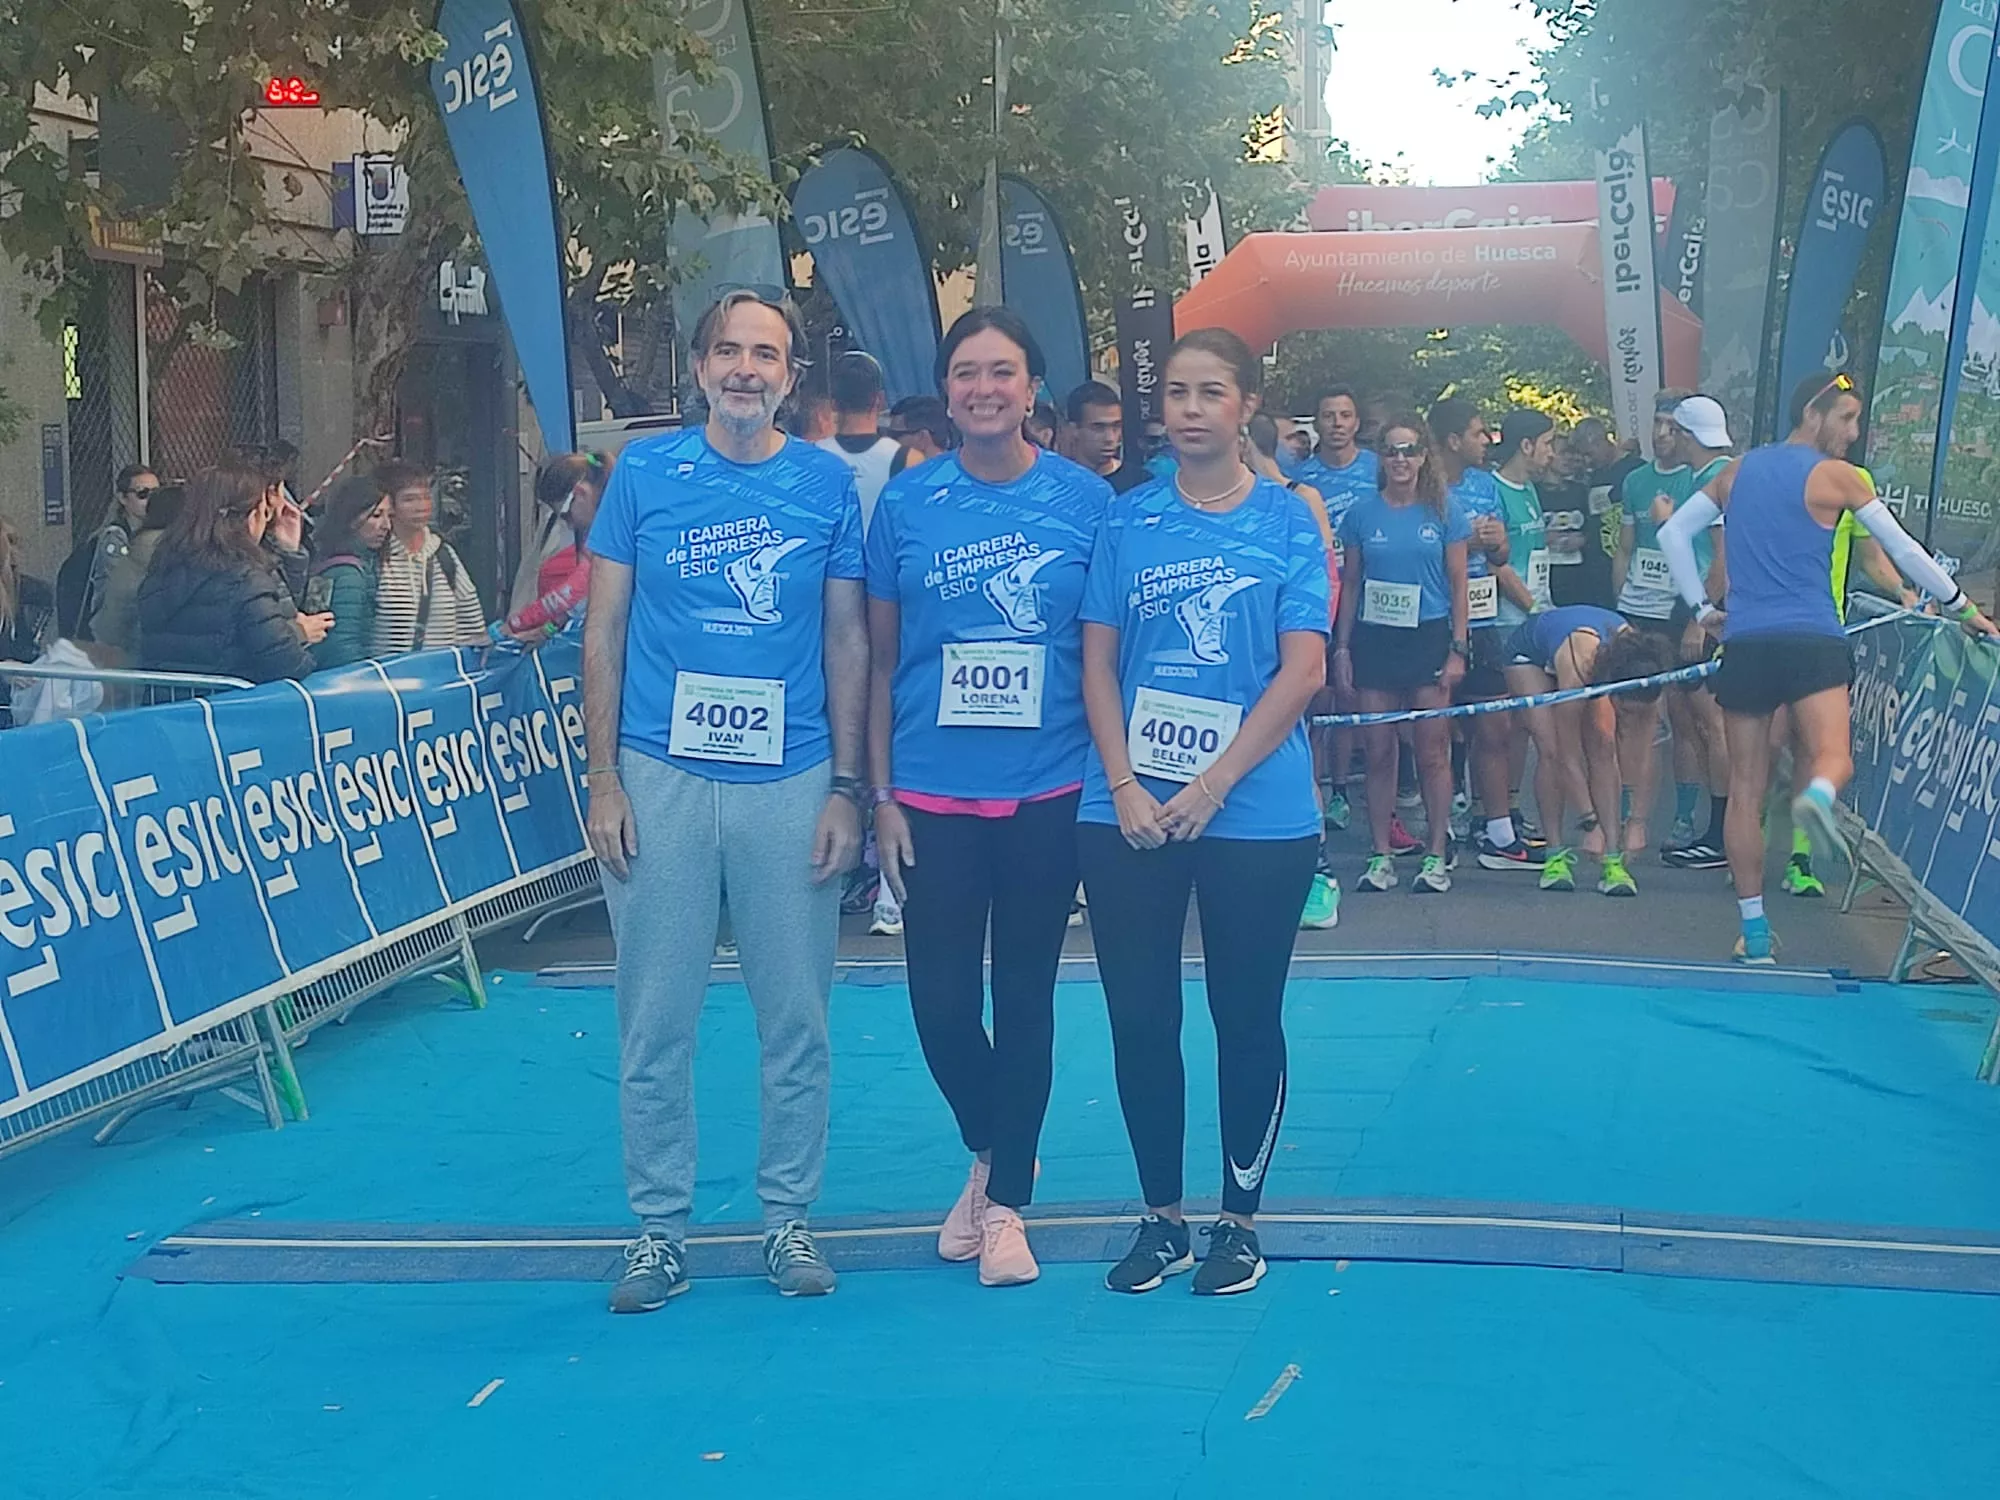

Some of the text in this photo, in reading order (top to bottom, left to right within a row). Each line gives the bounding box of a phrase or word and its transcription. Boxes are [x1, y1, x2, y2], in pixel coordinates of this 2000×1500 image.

[1822, 185, 1873, 228] esic
[1284, 244, 1557, 272] Ayuntamiento de Huesca
[1337, 269, 1502, 302] Hacemos deporte
[680, 515, 771, 546] I CARRERA
[666, 530, 783, 565] de EMPRESAS
[934, 531, 1027, 567] I CARRERA
[680, 558, 720, 579] ESIC
[924, 543, 1040, 588] de EMPRESAS
[1134, 555, 1224, 587] I CARRERA
[939, 577, 977, 600] ESIC
[1142, 568, 1236, 601] EMPRESAS
[1371, 590, 1411, 609] 3035
[951, 665, 1029, 691] 4001
[961, 693, 1020, 704] LORENA
[685, 702, 769, 731] 4002
[709, 732, 744, 744] IVAN
[1141, 718, 1219, 753] 4000
[1152, 748, 1197, 765] BELEN
[0, 832, 122, 949] esic
[135, 796, 243, 898] esic
[243, 772, 335, 861] esic
[334, 749, 412, 832] esic
[416, 729, 485, 807] esic
[490, 710, 559, 783] esic
